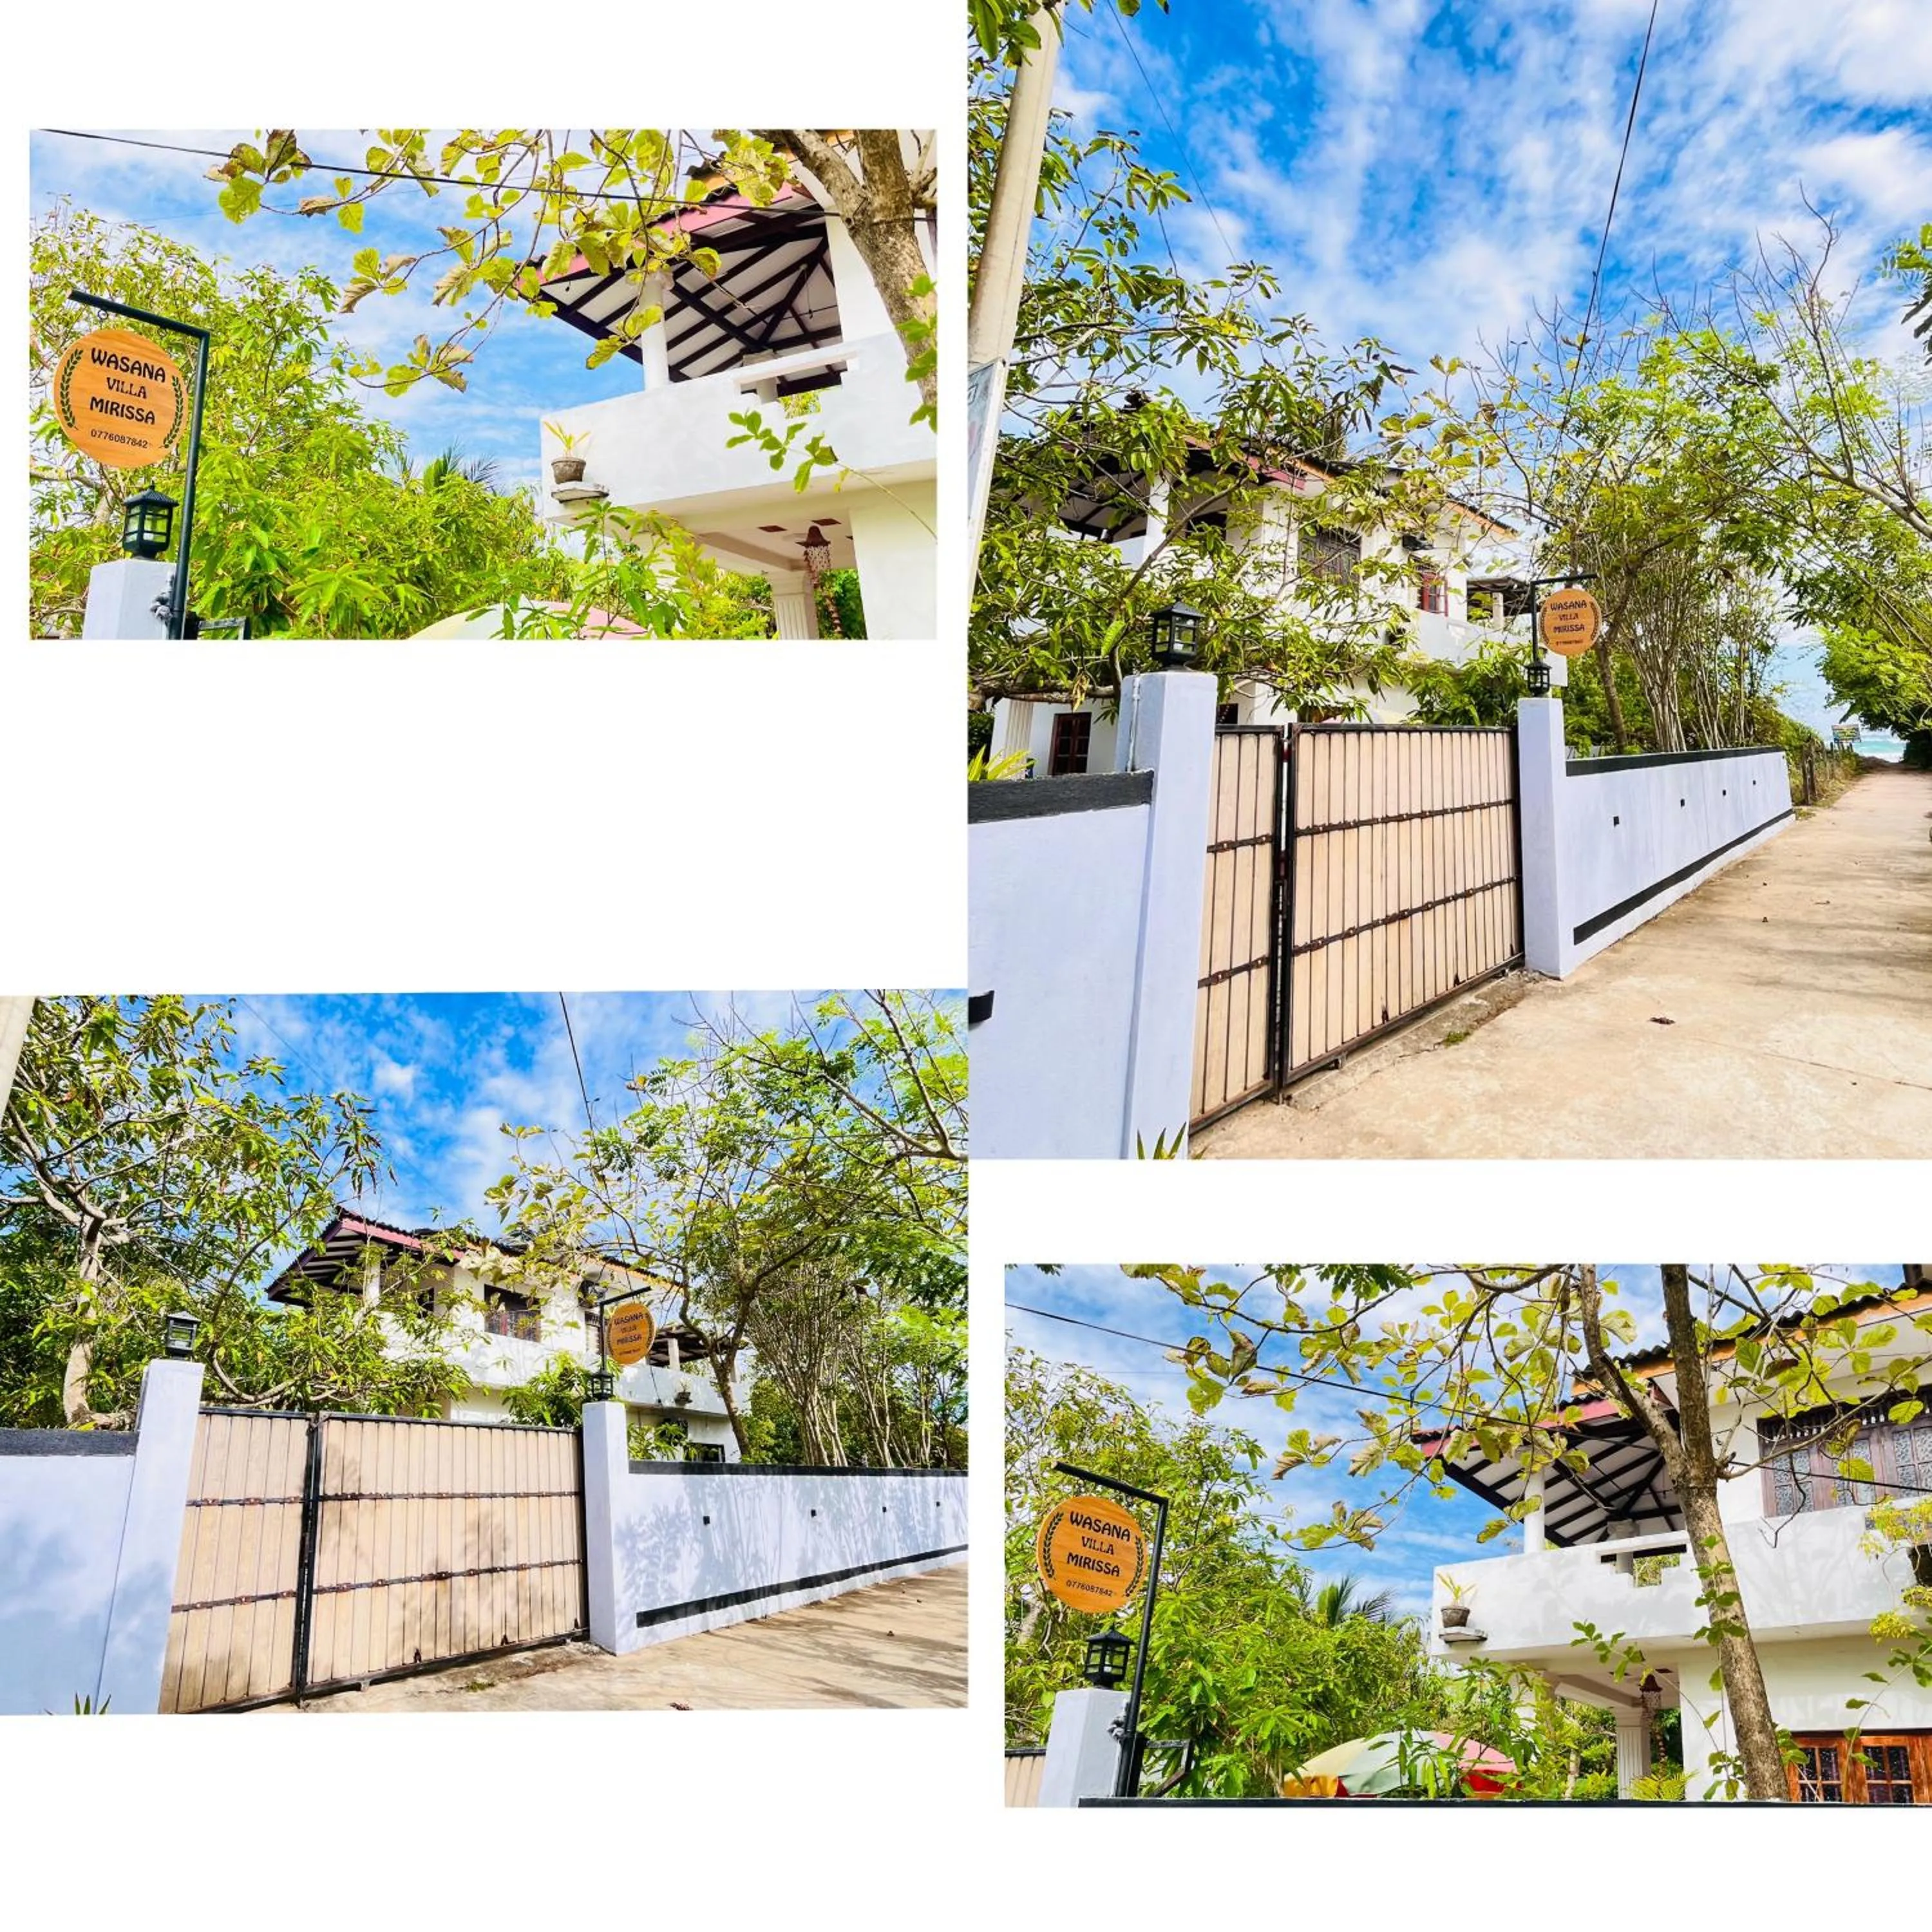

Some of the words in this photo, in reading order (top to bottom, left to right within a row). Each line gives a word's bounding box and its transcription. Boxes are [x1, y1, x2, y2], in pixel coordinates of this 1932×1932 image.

[91, 347, 166, 383] WASANA
[106, 377, 147, 399] VILLA
[90, 396, 155, 425] MIRISSA
[91, 429, 148, 448] 0776087842
[1550, 600, 1587, 611] WASANA
[1553, 623, 1585, 634] MIRISSA
[1070, 1511, 1130, 1542] WASANA
[1082, 1536, 1114, 1555] VILLA
[1066, 1552, 1120, 1577] MIRISSA
